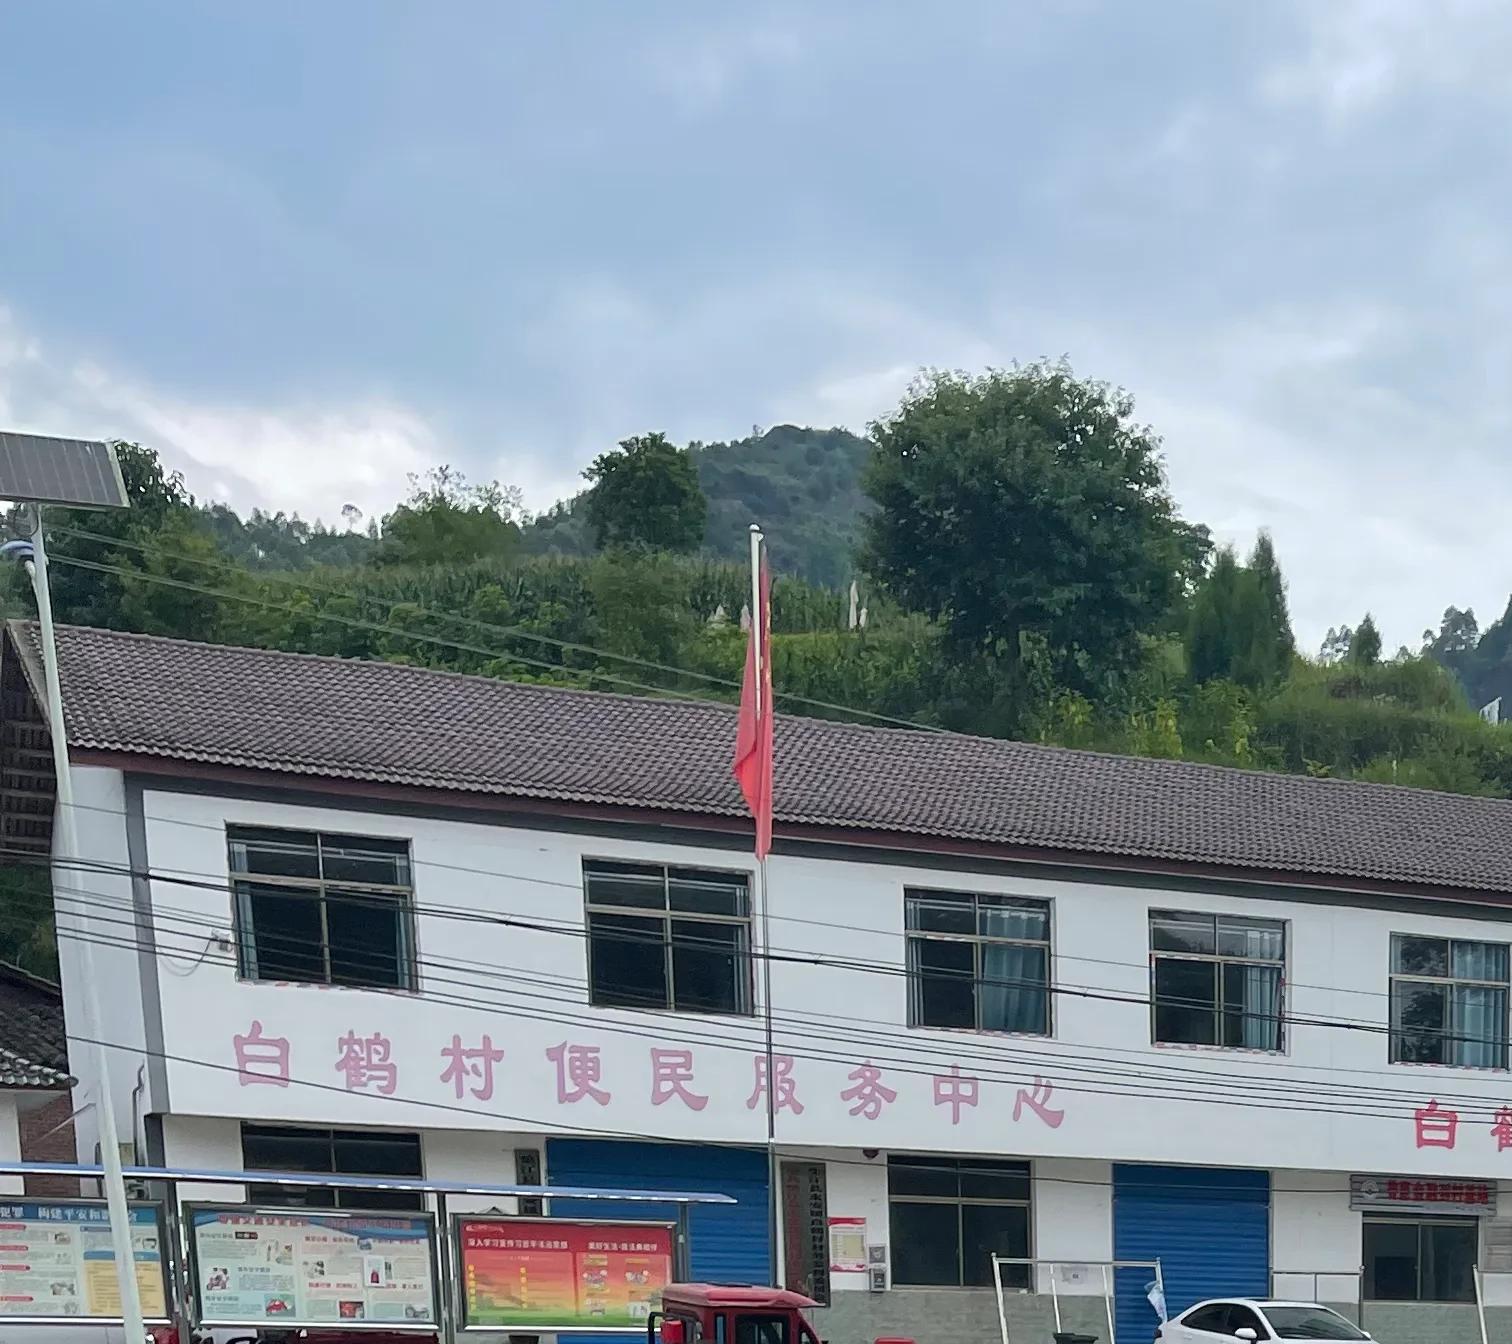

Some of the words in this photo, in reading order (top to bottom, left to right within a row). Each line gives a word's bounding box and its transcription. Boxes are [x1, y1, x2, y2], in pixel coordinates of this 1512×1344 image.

[234, 1020, 1066, 1129] 白鹤村便民服务中心
